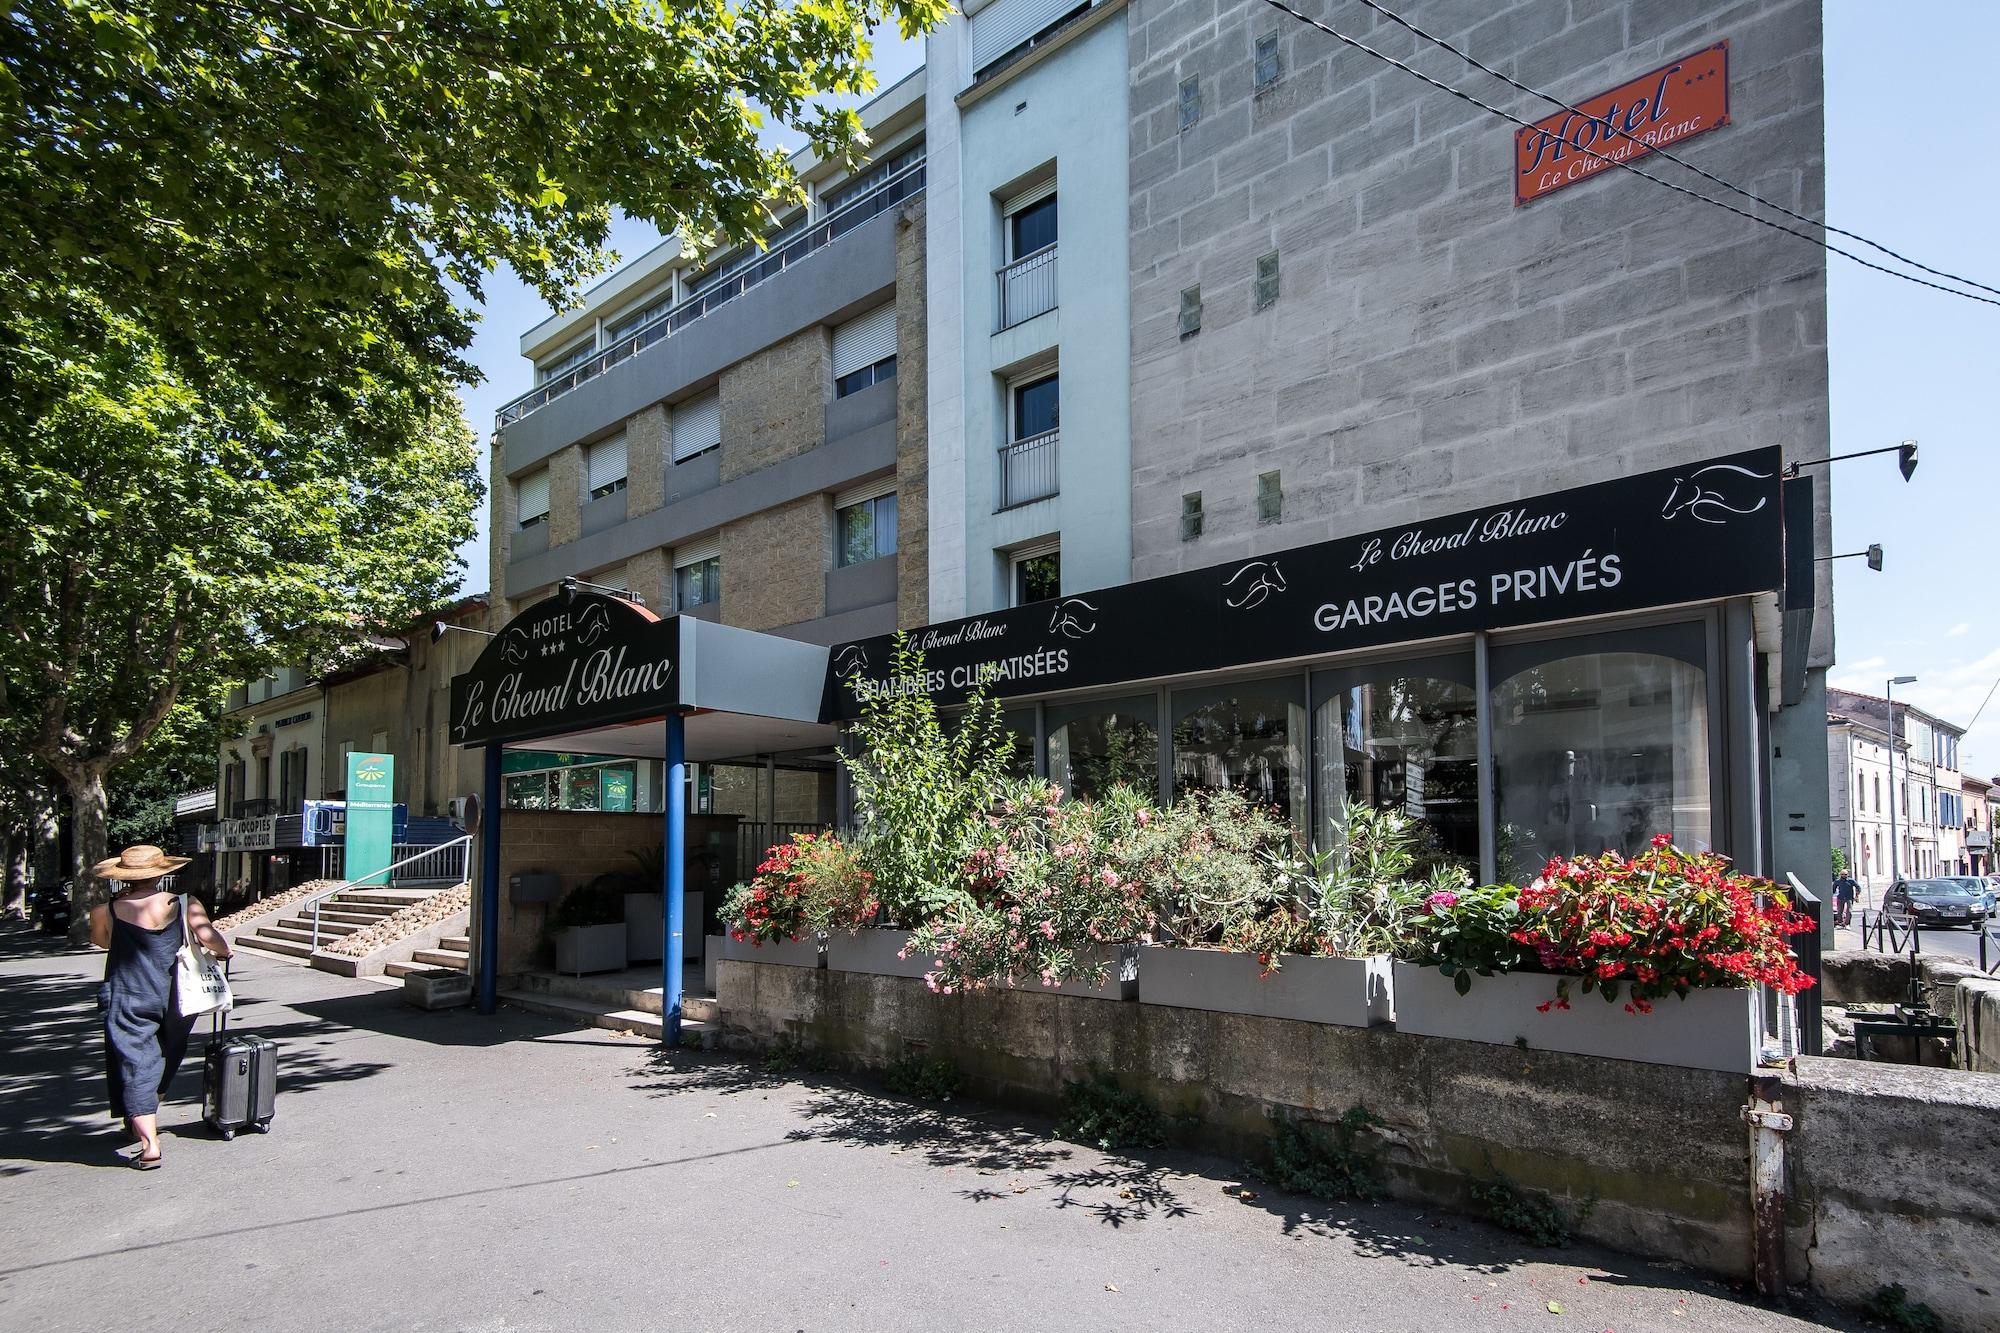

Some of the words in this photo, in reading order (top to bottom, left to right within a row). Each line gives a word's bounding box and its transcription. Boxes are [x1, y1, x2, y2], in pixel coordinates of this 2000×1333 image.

[1537, 172, 1562, 192] Le
[1567, 135, 1634, 181] Cheval
[1639, 114, 1702, 150] Blanc
[1350, 537, 1384, 574] Le
[1390, 517, 1477, 560] Cheval
[1479, 508, 1570, 543] Blanc
[533, 612, 573, 639] HOTEL
[1313, 581, 1477, 632] GARAGES
[1491, 549, 1624, 605] PRIVÉS
[922, 624, 966, 651] Cheval
[965, 620, 1007, 642] Blanc
[454, 680, 484, 739] Le
[491, 658, 578, 723] Cheval
[577, 645, 674, 706] Blanc
